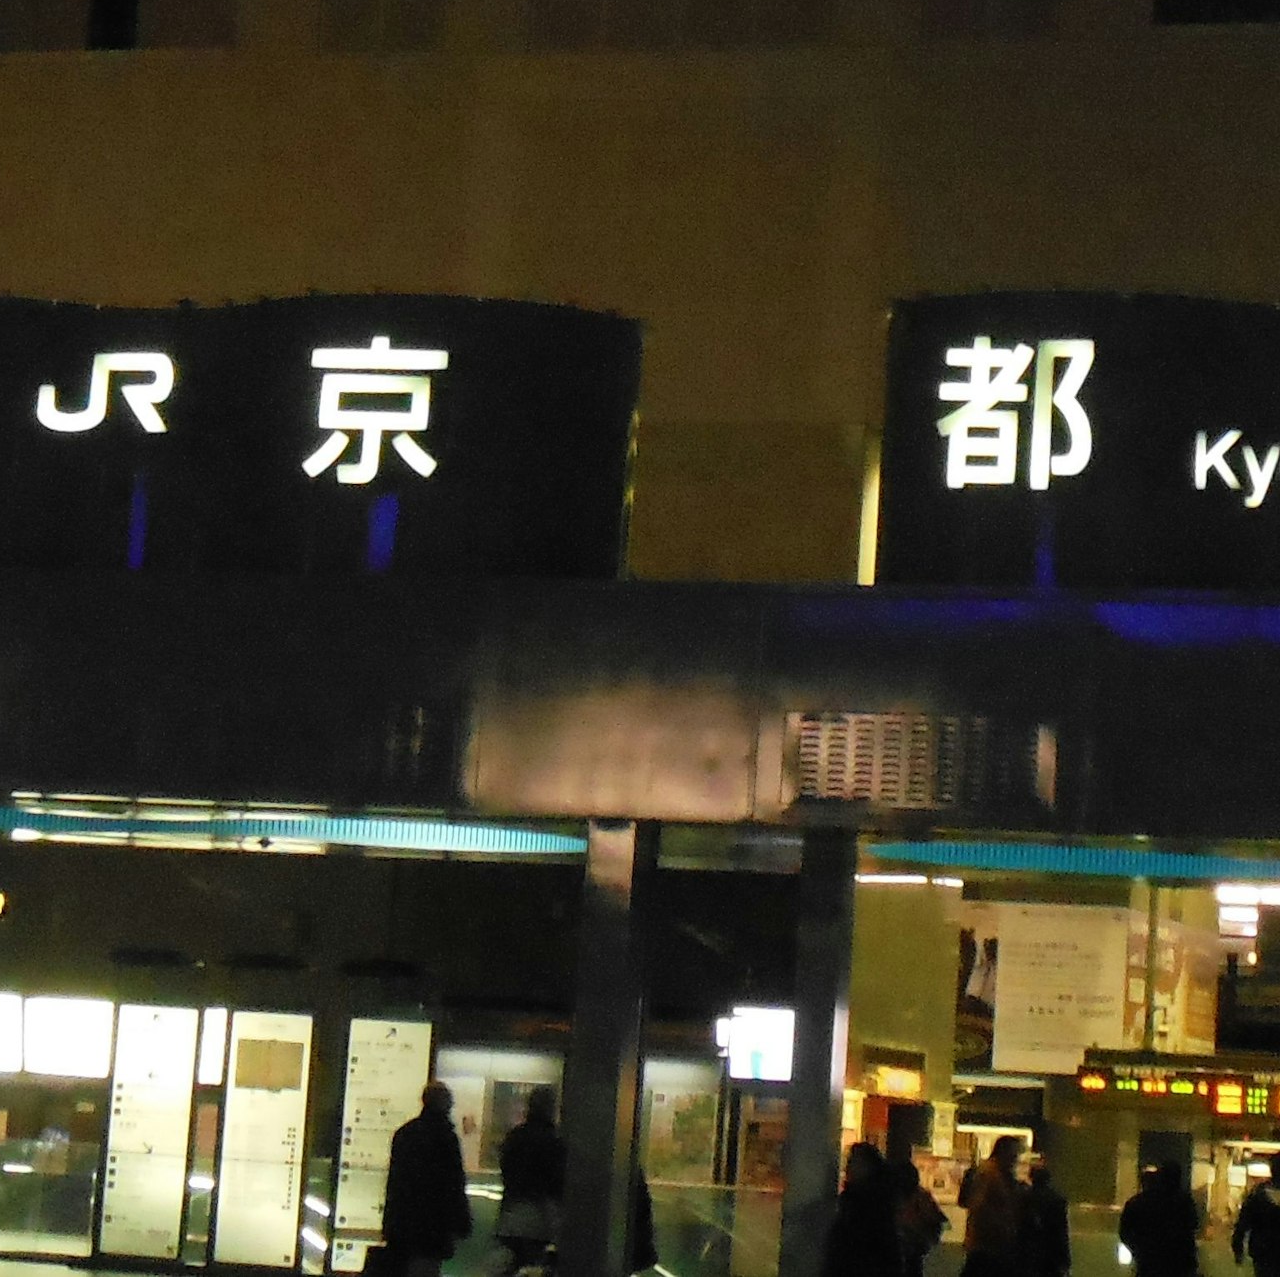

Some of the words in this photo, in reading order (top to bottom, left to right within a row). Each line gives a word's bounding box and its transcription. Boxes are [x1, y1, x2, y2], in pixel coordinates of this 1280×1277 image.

[34, 350, 177, 434] JR
[301, 335, 449, 485] 京
[936, 335, 1095, 491] 都
